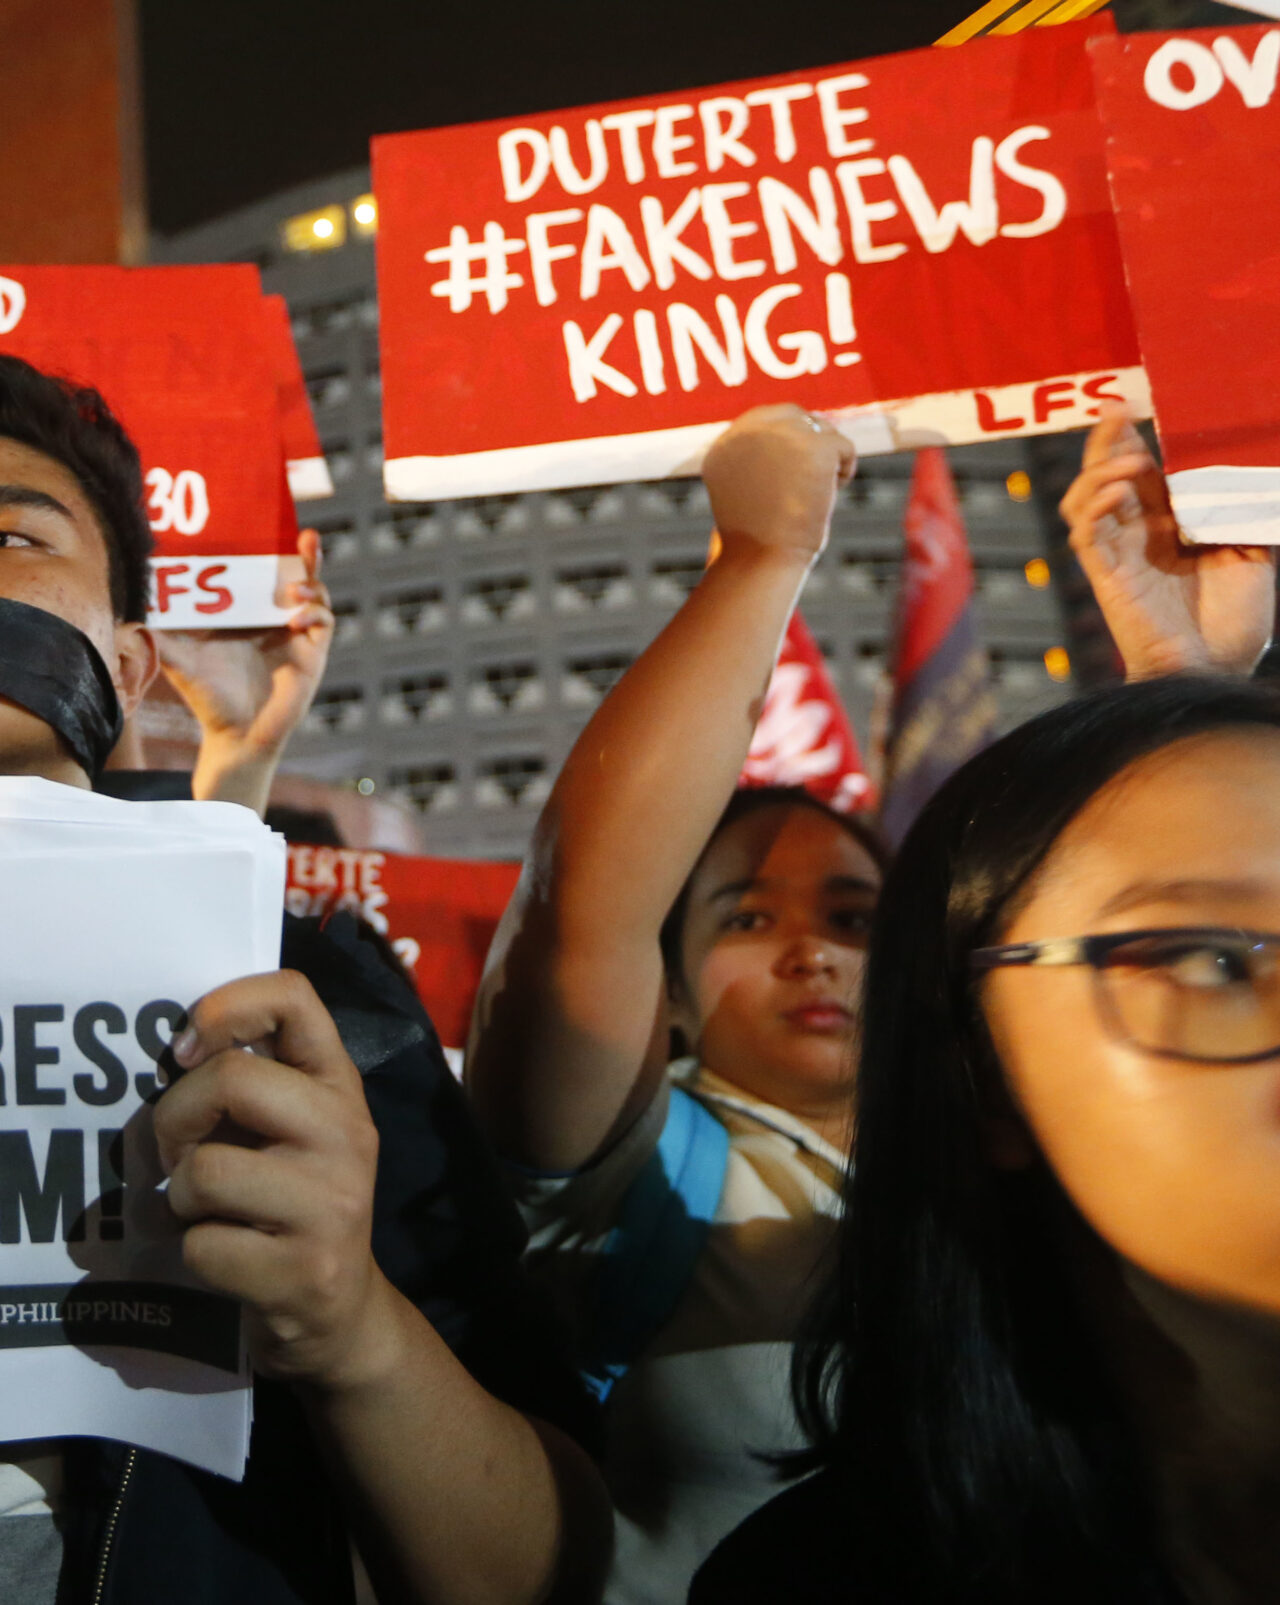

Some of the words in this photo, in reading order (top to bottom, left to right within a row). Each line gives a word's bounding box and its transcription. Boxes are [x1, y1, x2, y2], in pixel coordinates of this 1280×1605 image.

[497, 73, 875, 203] DUTERTE
[424, 125, 1068, 315] #FAKENEWS
[562, 271, 862, 404] KING!
